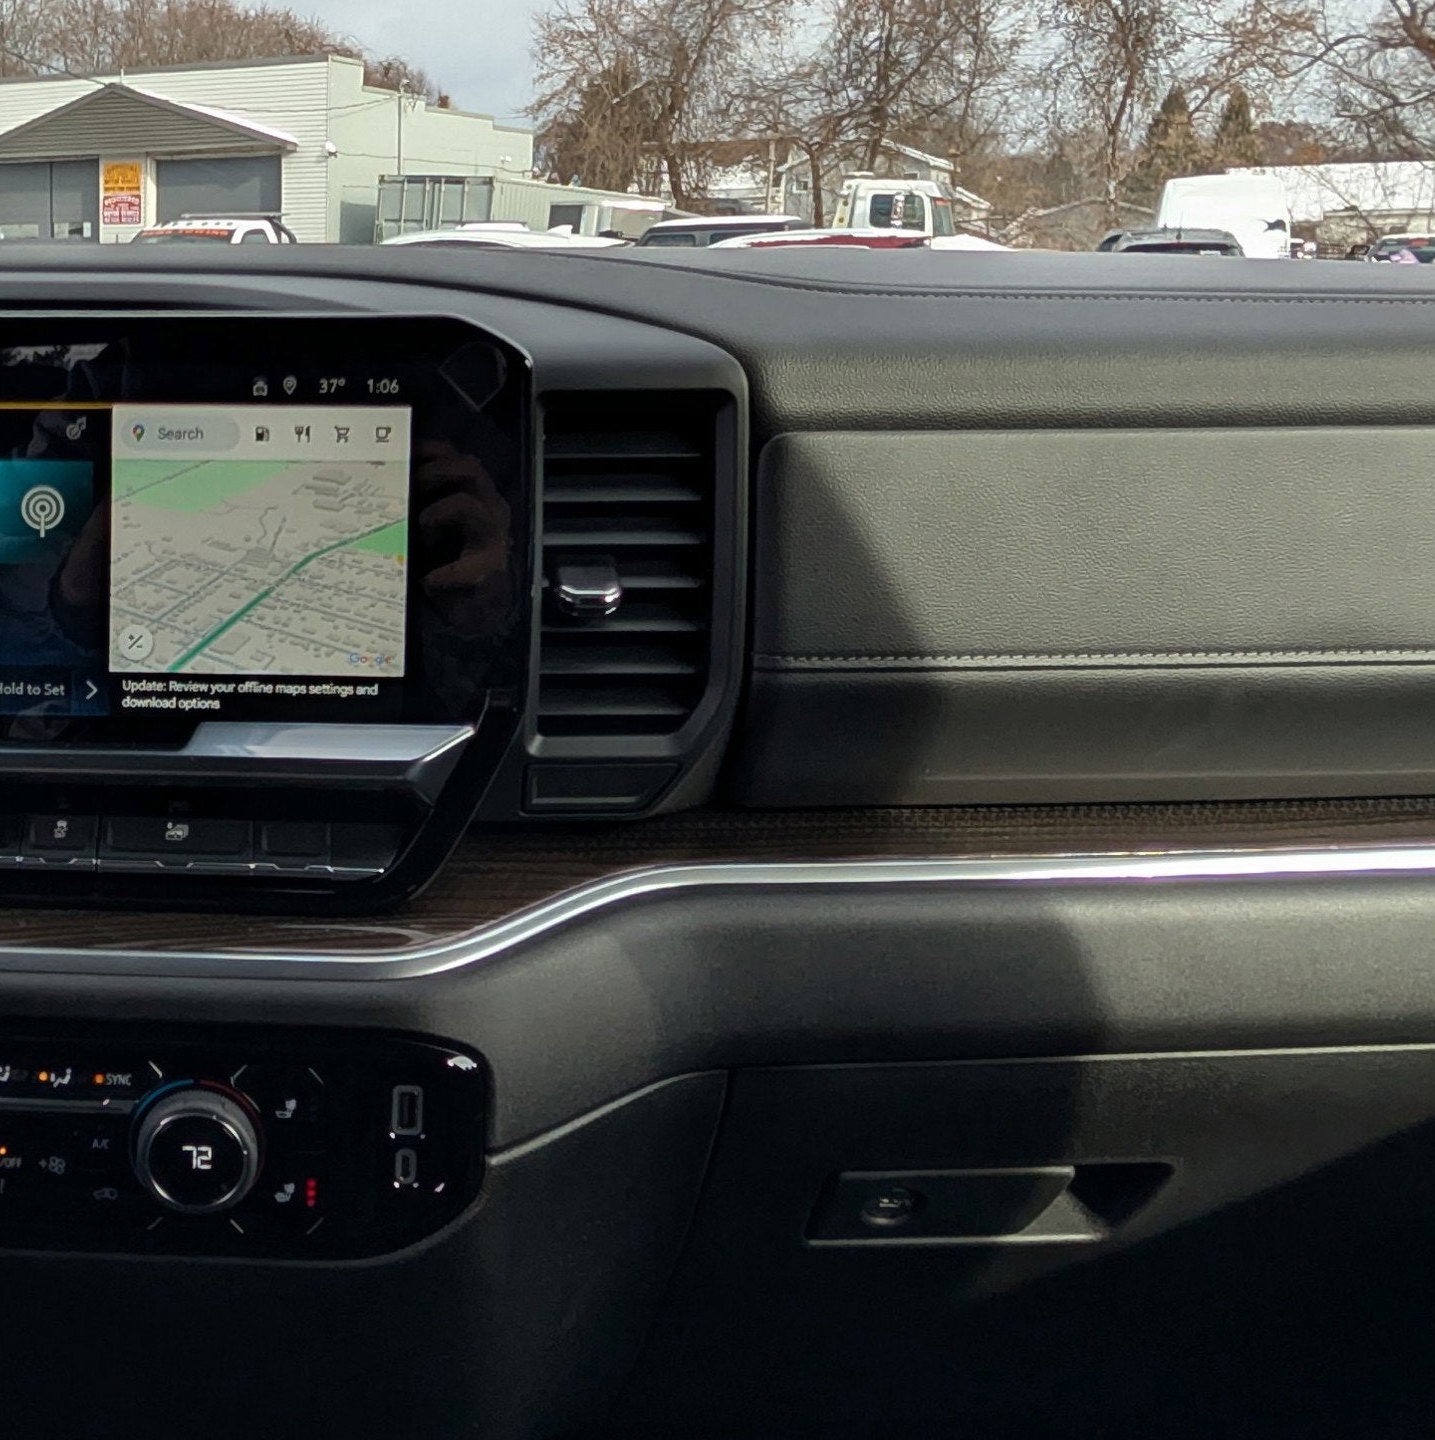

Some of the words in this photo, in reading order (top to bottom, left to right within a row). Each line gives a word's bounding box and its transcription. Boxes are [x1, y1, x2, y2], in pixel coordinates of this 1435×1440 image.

[367, 378, 400, 394] 1:06
[157, 426, 205, 441] Search
[26, 682, 41, 696] to
[44, 683, 65, 696] Set
[122, 679, 167, 693] Update:
[169, 680, 209, 693] Review
[210, 683, 236, 695] your
[238, 681, 272, 694] offline
[275, 684, 307, 696] maps
[308, 683, 354, 698] settings
[356, 683, 379, 695] and
[122, 696, 176, 709] download
[178, 697, 220, 710] options
[105, 1072, 131, 1086] SYNC
[92, 1138, 111, 1150] A/C
[182, 1146, 213, 1169] 72
